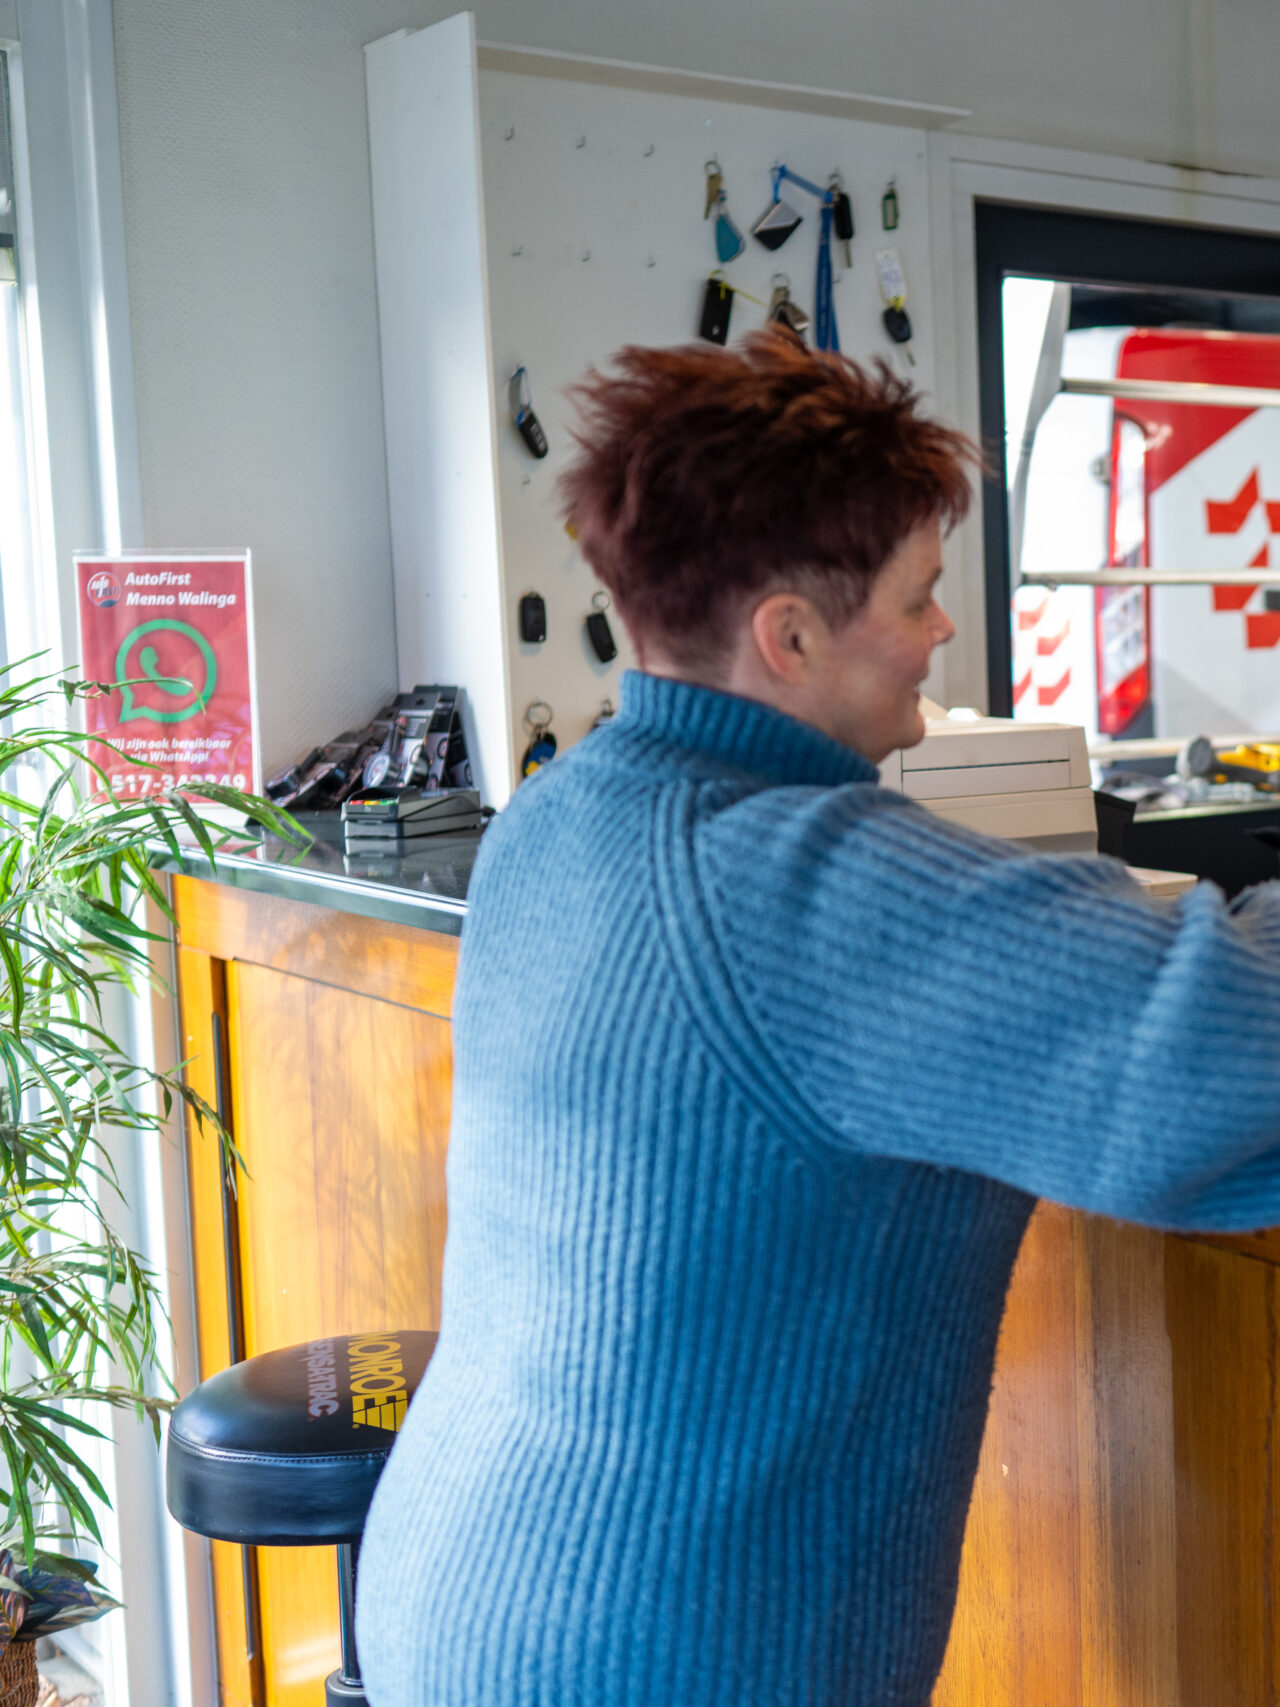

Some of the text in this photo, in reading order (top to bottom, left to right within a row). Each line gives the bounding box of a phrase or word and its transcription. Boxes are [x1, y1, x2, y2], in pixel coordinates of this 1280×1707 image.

[124, 571, 192, 586] AutoFirst
[125, 591, 236, 608] Menno Walinga
[126, 738, 146, 751] zijn
[148, 738, 170, 749] ook
[171, 738, 232, 750] bereikbaar
[150, 751, 209, 763] WhatsApp!
[306, 1339, 340, 1418] ENSATRAC
[347, 1331, 408, 1412] MONROE
